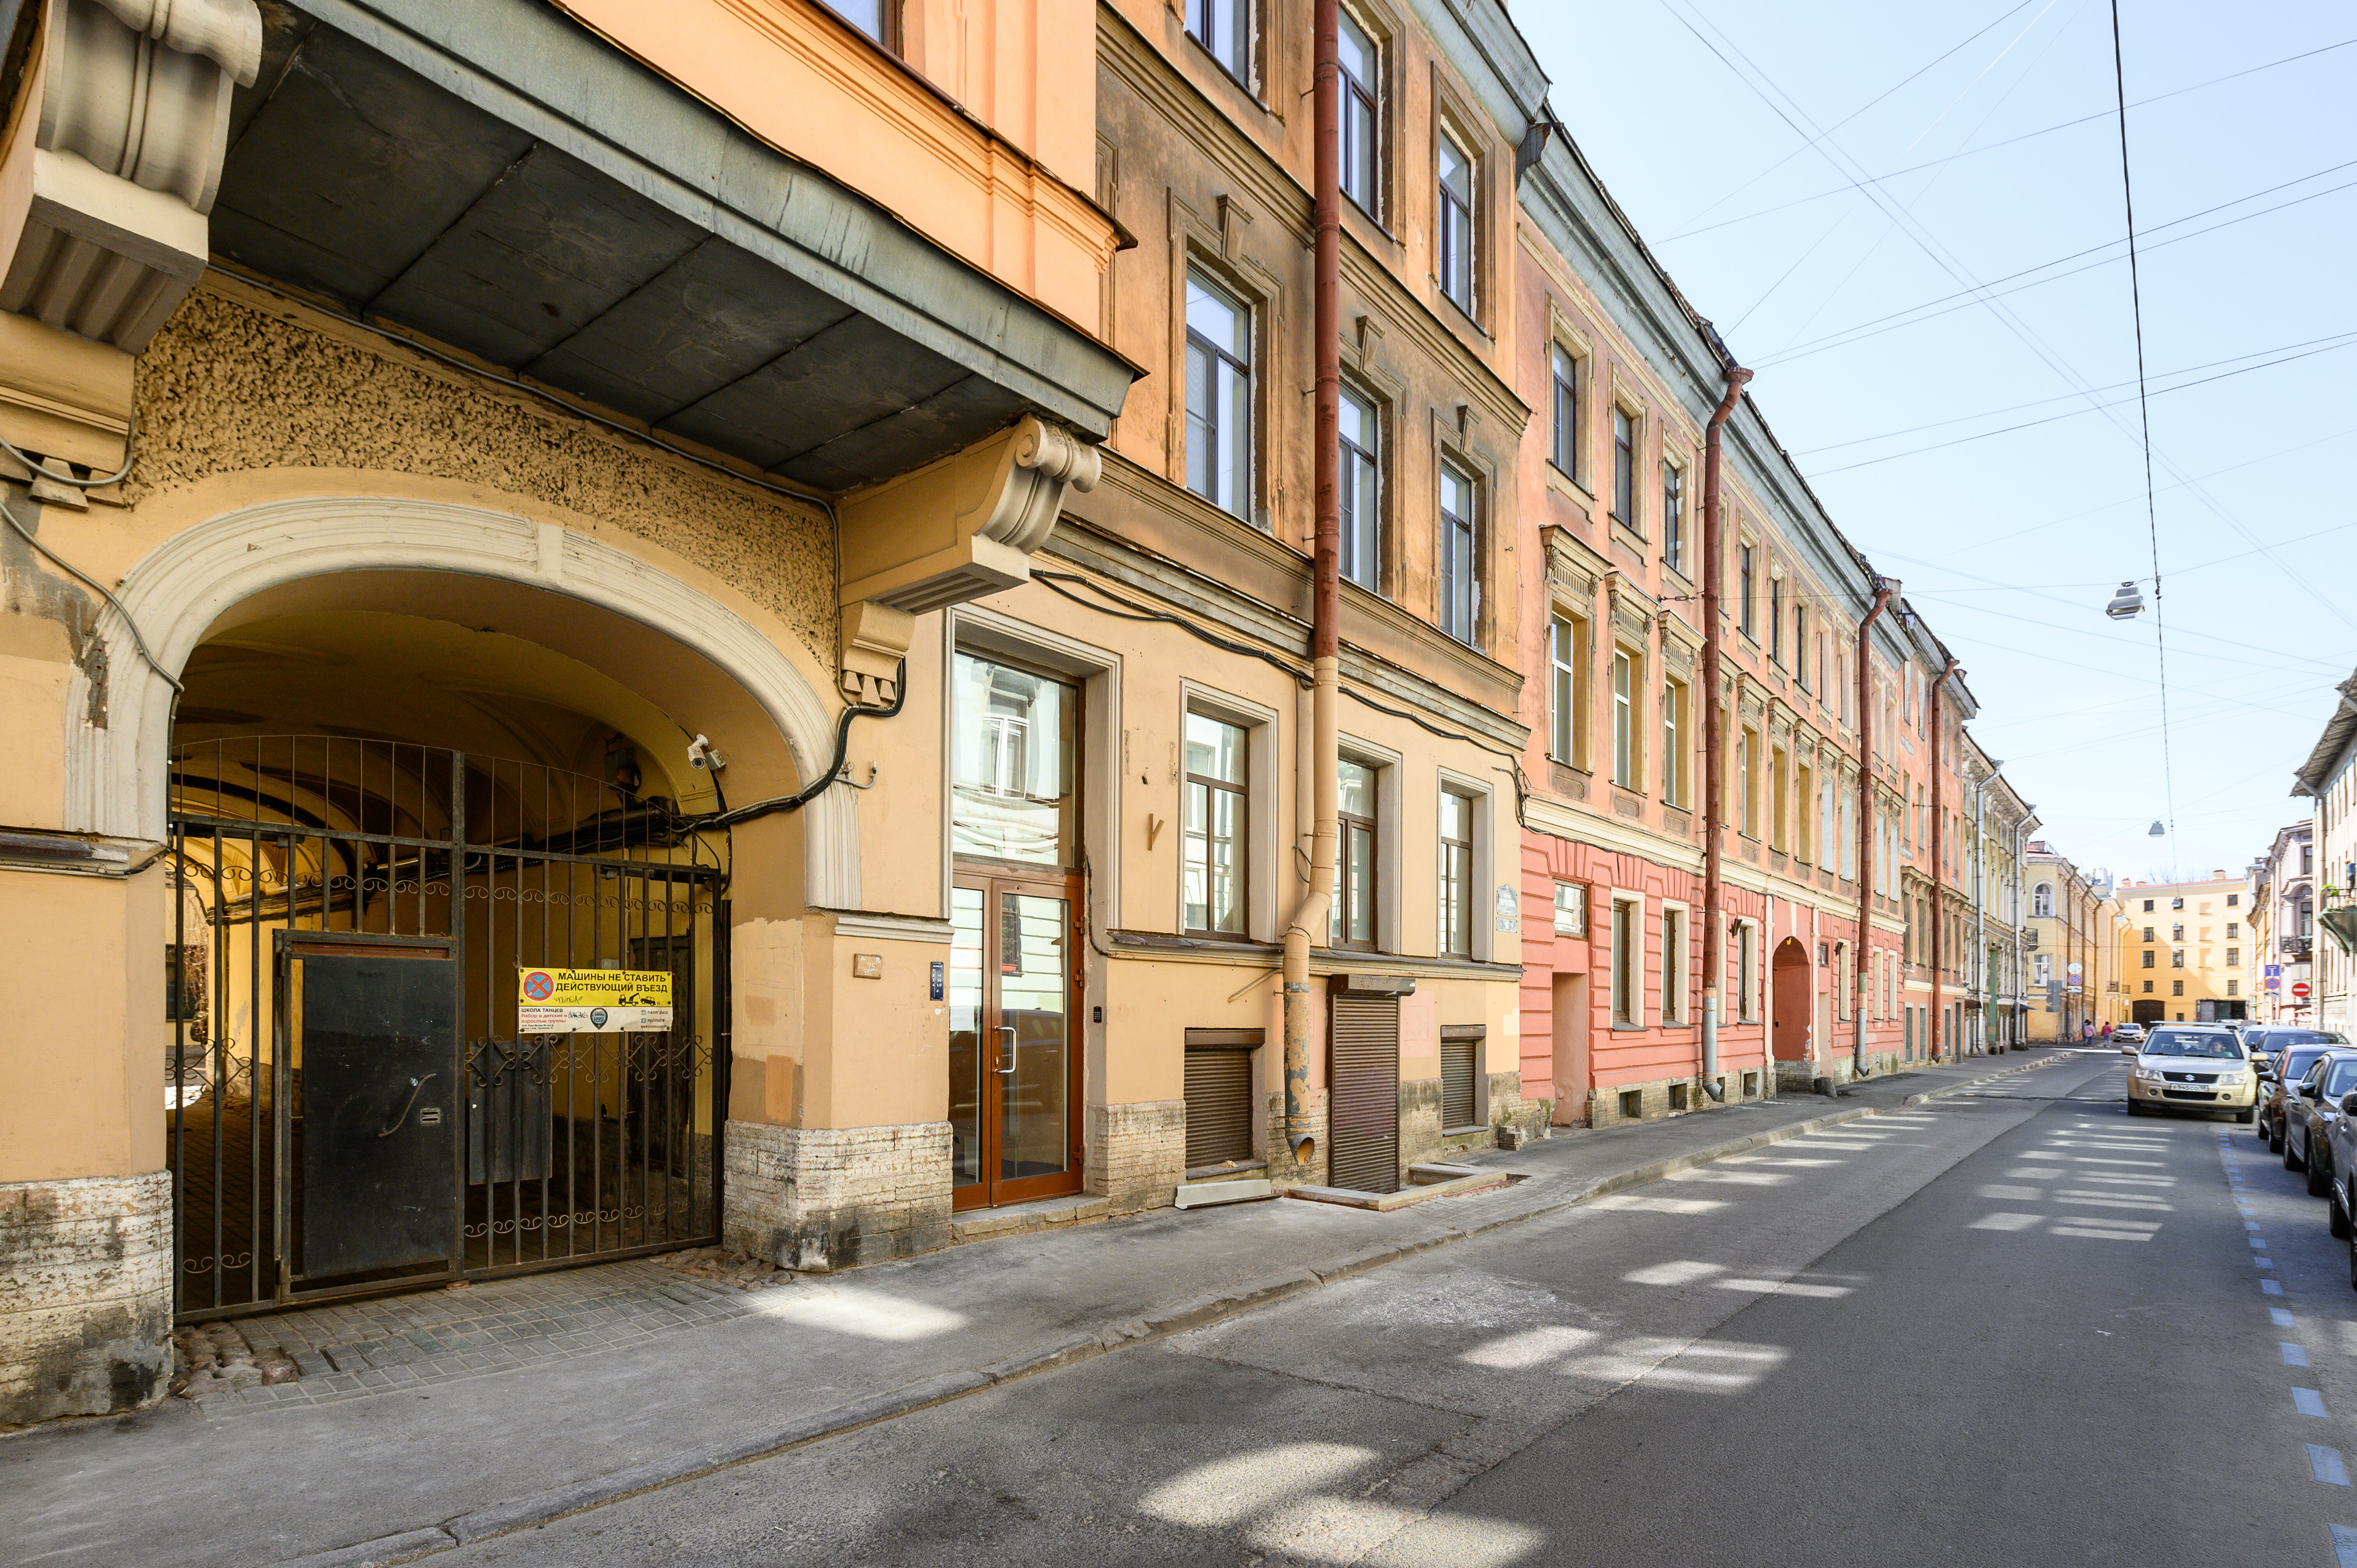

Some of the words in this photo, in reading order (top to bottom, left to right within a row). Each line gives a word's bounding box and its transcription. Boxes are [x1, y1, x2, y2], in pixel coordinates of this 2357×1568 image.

[1498, 898, 1516, 908] ПИРОГОВА
[558, 973, 605, 981] МАШИНЫ
[556, 982, 633, 992] ДЕЙСТВУЮЩИЙ
[636, 984, 667, 993] ВЪЕЗД
